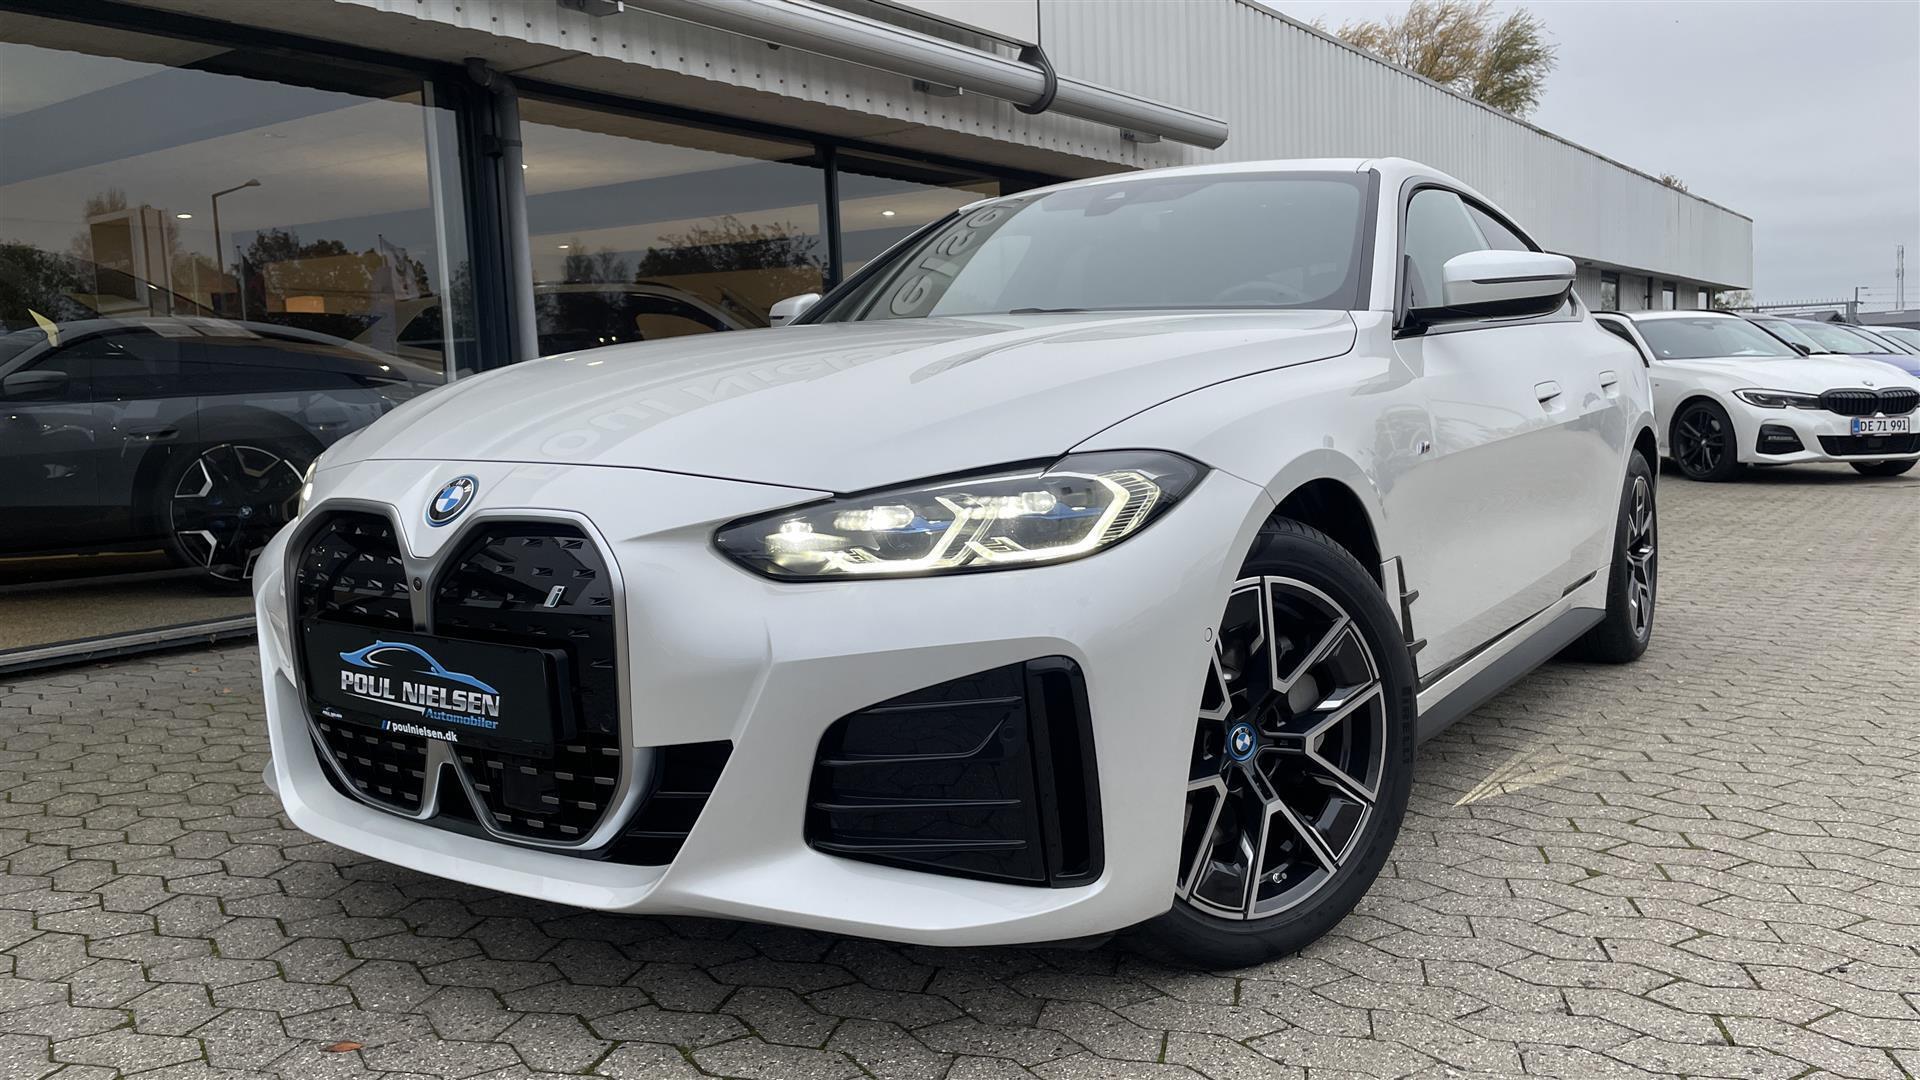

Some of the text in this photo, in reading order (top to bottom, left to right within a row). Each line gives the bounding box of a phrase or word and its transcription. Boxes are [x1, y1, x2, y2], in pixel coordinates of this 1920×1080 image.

[1860, 420, 1906, 432] DE 71 991
[341, 670, 500, 717] POUL NIELSEN
[425, 708, 499, 729] Automobiler
[391, 722, 458, 743] poulnielsen.dk
